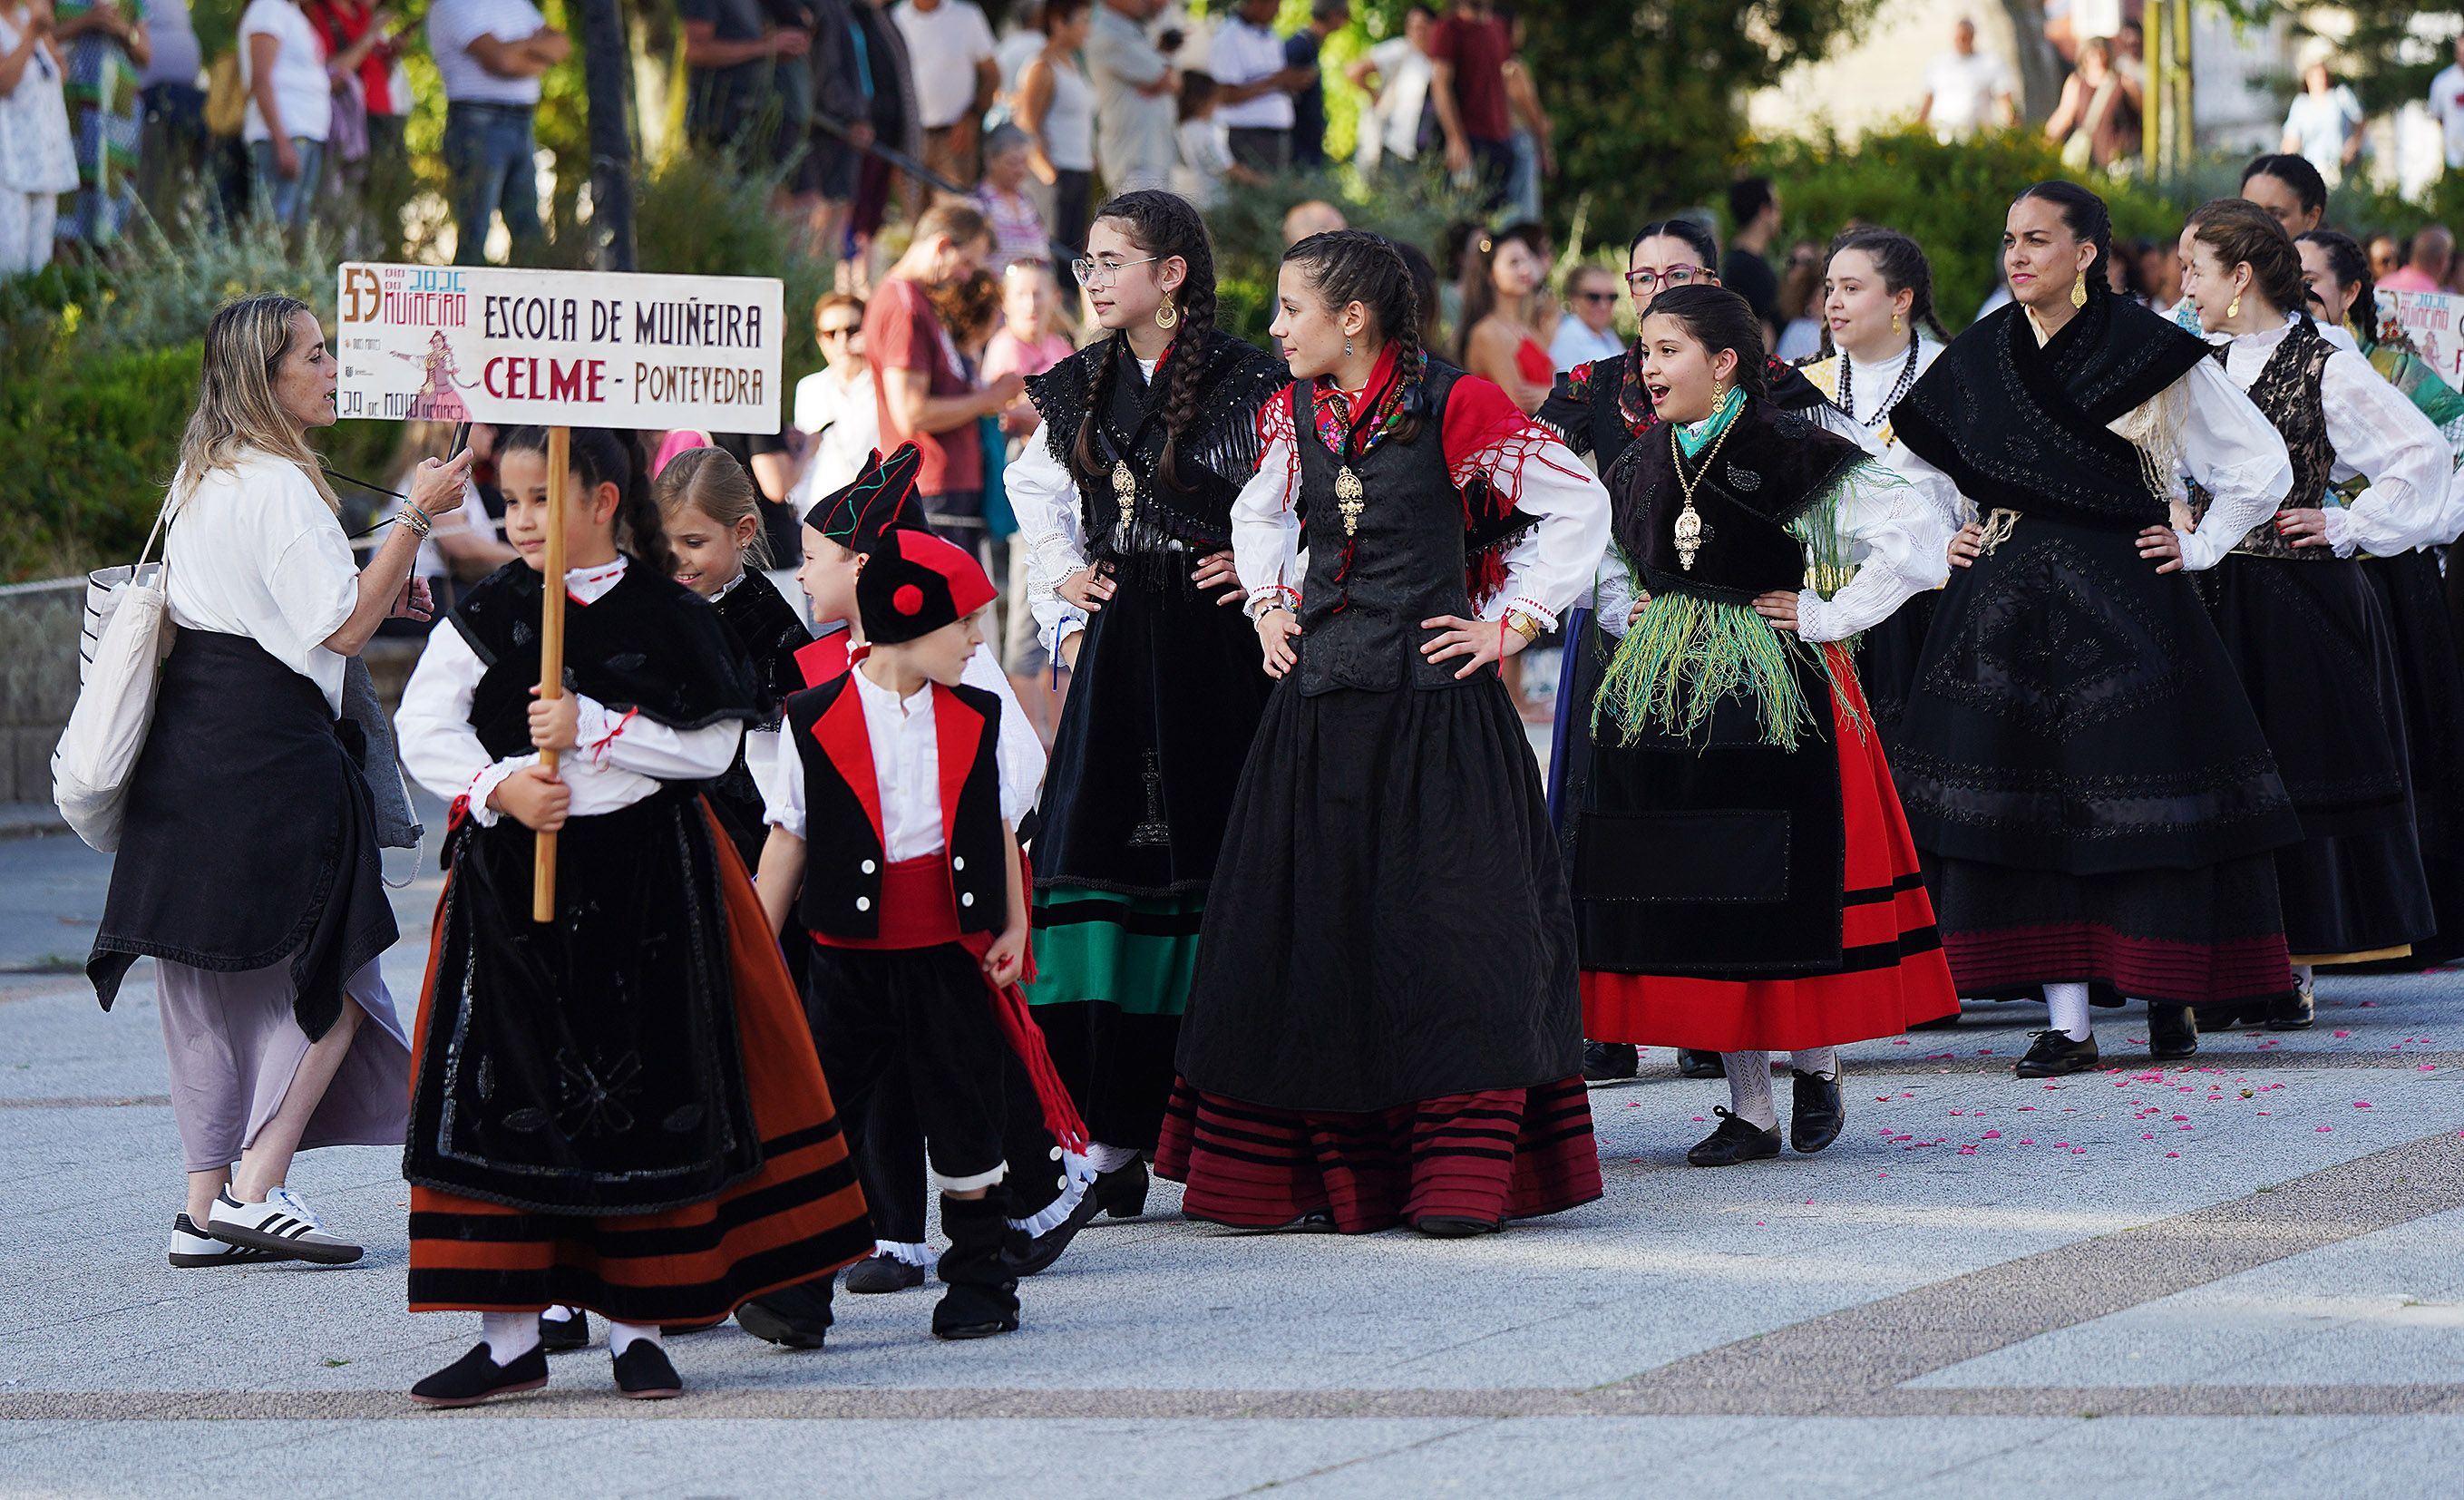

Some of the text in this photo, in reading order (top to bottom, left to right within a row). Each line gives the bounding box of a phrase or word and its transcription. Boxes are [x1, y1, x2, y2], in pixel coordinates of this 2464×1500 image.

[344, 268, 381, 322] 53
[483, 295, 763, 348] ESCOLA DE MUIÑEIRA
[344, 391, 364, 415] 29
[483, 356, 607, 405] CELME
[635, 362, 764, 405] PONTEVEDRA
